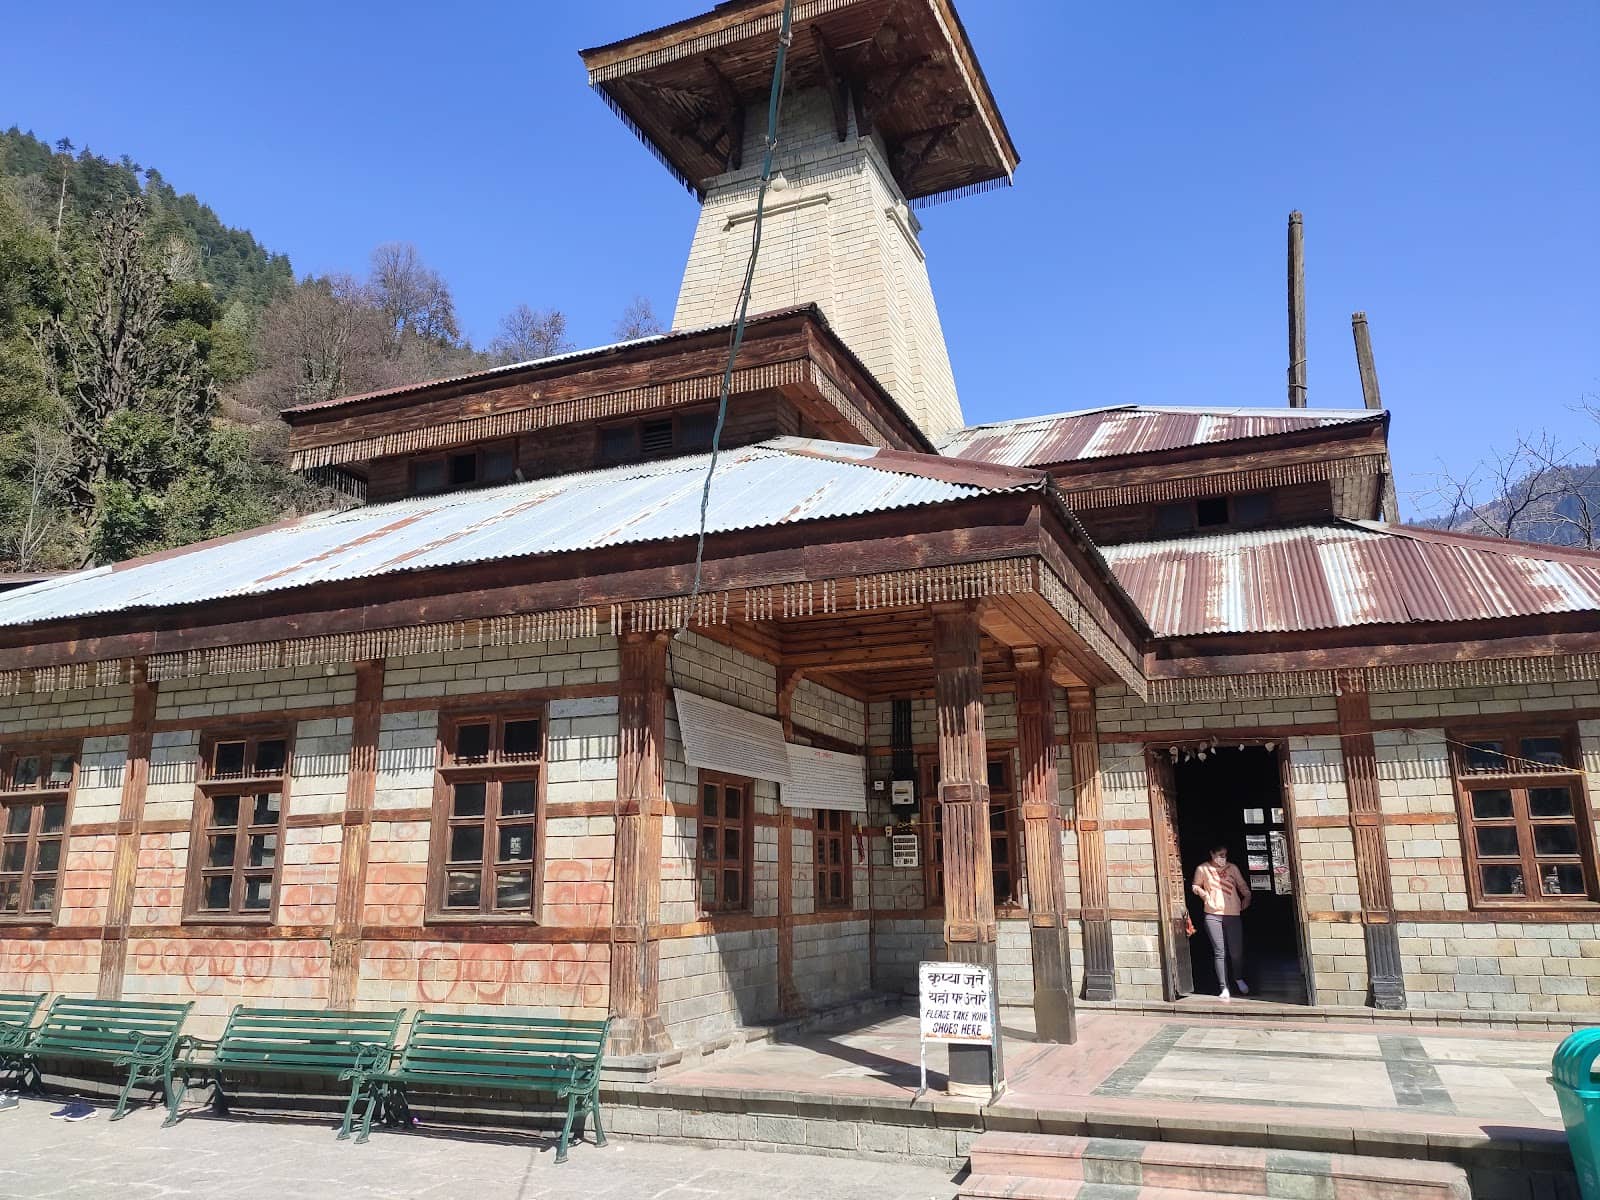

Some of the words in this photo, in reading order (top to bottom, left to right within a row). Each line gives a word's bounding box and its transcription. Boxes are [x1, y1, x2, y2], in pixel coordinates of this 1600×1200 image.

[964, 970, 986, 988] जूते
[929, 990, 950, 1004] यहां
[952, 993, 963, 1004] पर
[926, 1010, 950, 1019] PLEASE
[953, 1010, 968, 1021] TAKE
[972, 1012, 988, 1021] YOUR
[933, 1022, 958, 1033] SHOES
[961, 1023, 982, 1036] HERE
